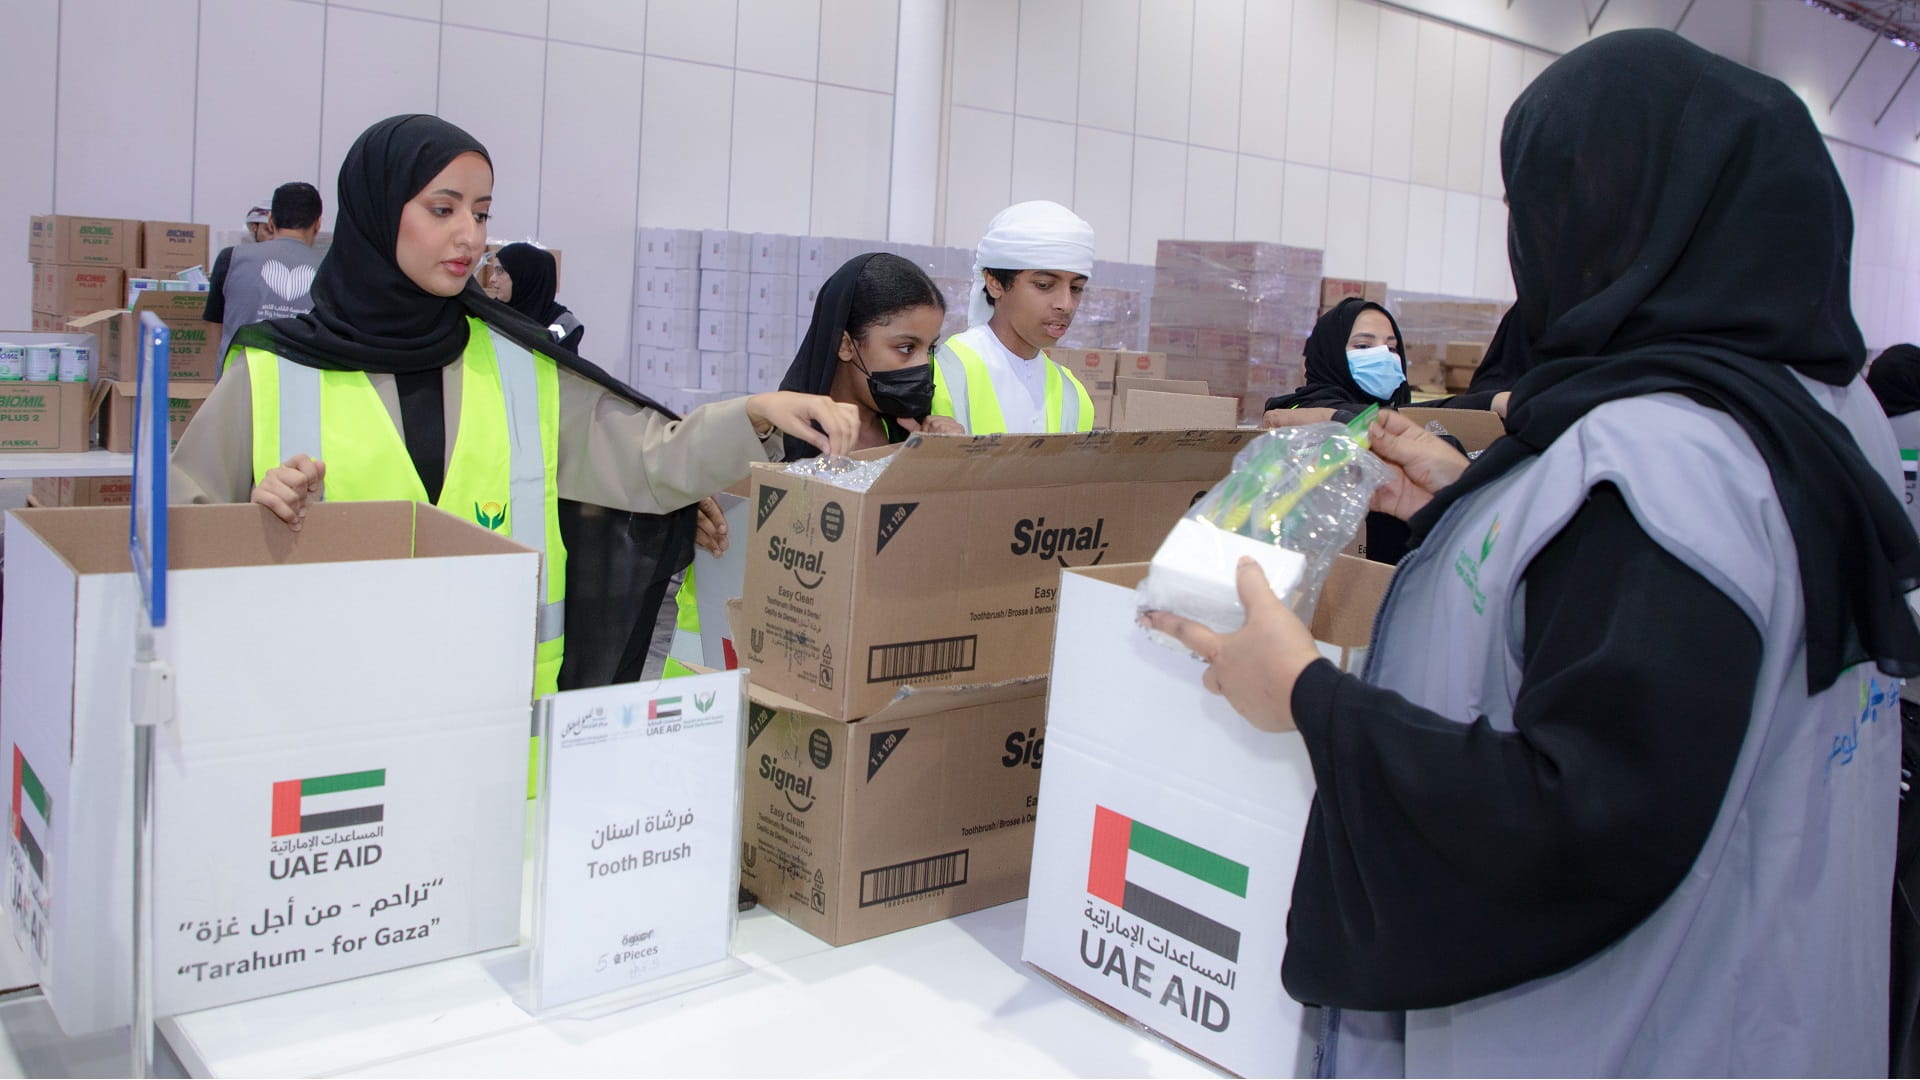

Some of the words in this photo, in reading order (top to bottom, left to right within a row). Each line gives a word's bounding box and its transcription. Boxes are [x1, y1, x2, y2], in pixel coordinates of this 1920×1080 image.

[0, 414, 29, 422] PLUS
[33, 414, 40, 422] 2
[767, 490, 779, 507] 120
[892, 507, 907, 526] 120
[778, 585, 794, 601] Easy
[795, 591, 815, 607] Clean
[1034, 586, 1057, 601] Easy
[646, 725, 664, 737] UAE
[666, 723, 682, 734] AID
[883, 732, 898, 752] 120
[1002, 728, 1043, 770] Sig
[644, 808, 695, 833] فرشاة
[770, 804, 785, 822] Easy
[786, 811, 805, 829] Clean
[270, 836, 319, 856] الإماراتية
[320, 825, 385, 847] المساعدات
[591, 818, 640, 850] اسنان
[270, 851, 329, 881] UAE
[334, 843, 383, 872] AID
[587, 855, 638, 879] Tooth
[642, 842, 692, 868] Brush
[250, 896, 294, 936] أجل
[304, 902, 342, 927] من
[1083, 899, 1144, 949] الإماراتية
[332, 933, 368, 956] for
[623, 945, 659, 962] Pieces
[1146, 936, 1236, 991] المساعدات
[1080, 928, 1155, 999] UAE
[1159, 974, 1231, 1034] AID
